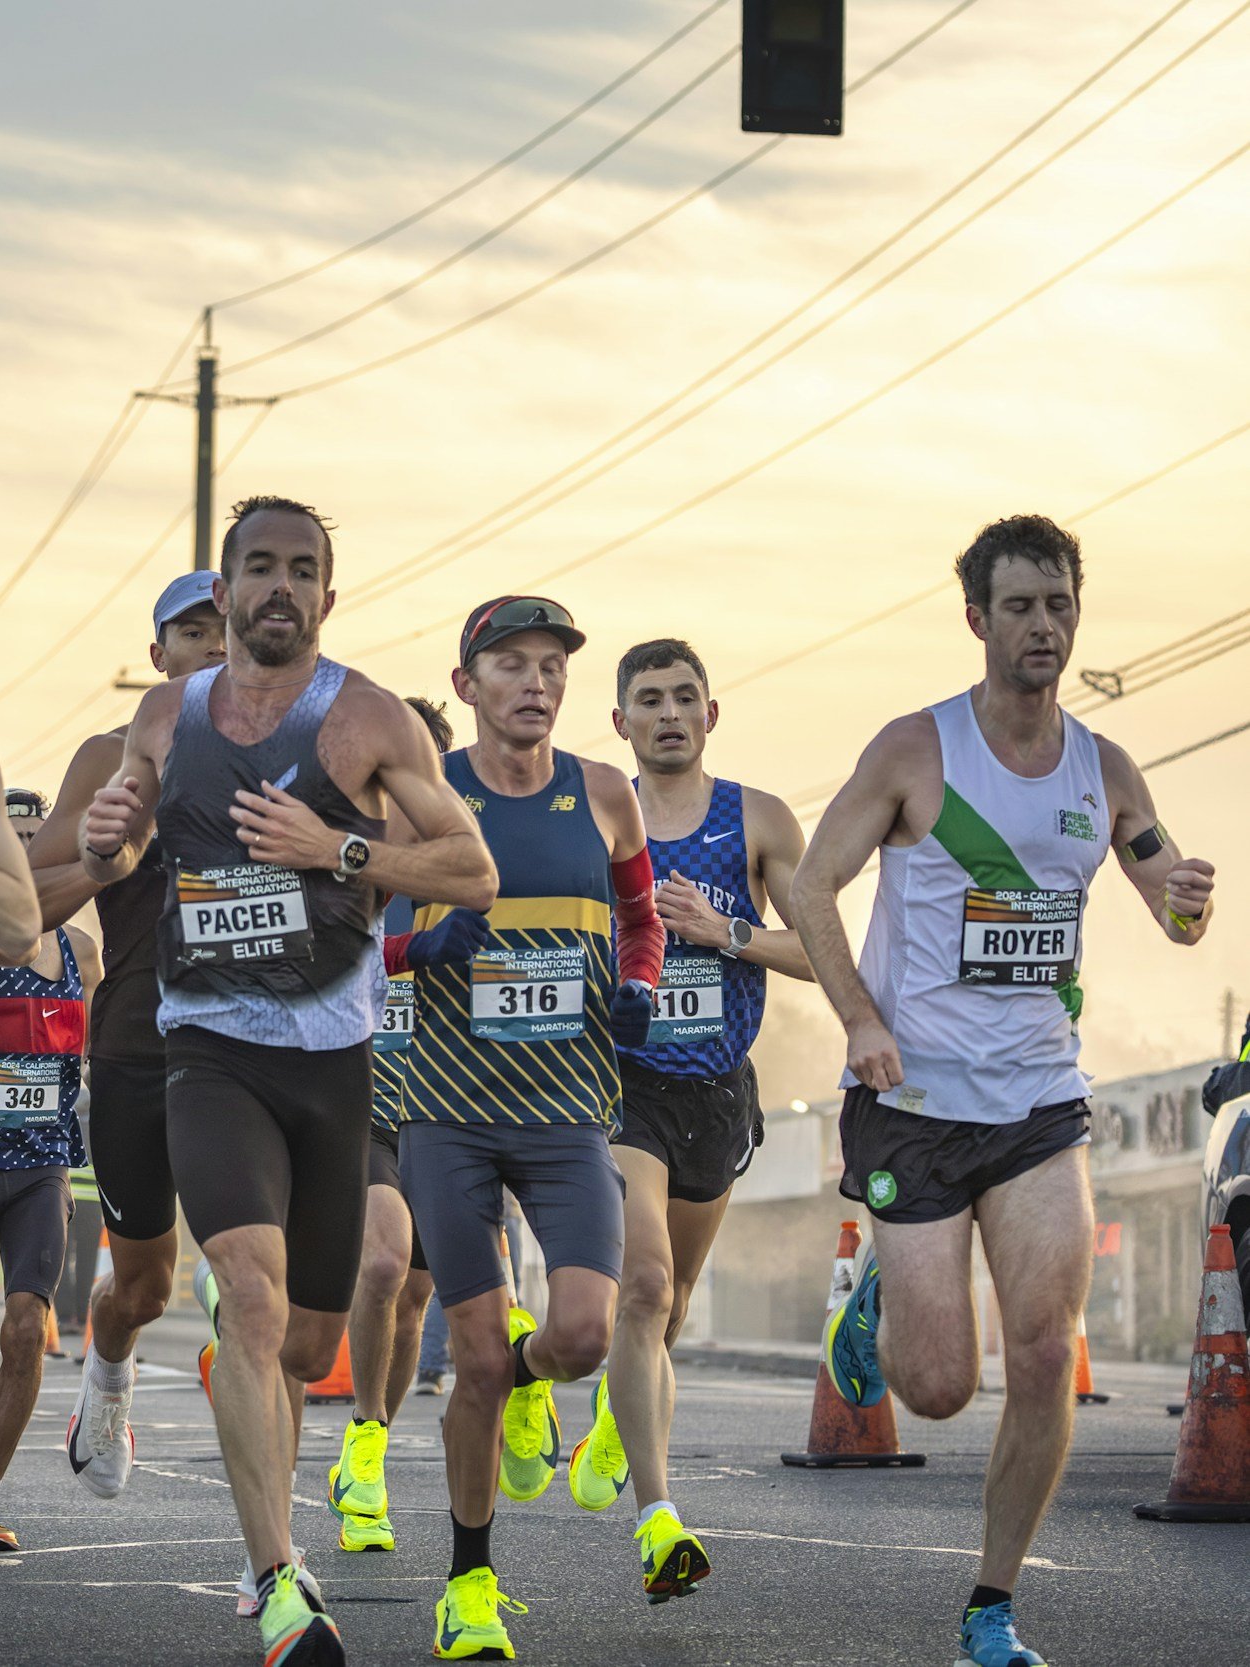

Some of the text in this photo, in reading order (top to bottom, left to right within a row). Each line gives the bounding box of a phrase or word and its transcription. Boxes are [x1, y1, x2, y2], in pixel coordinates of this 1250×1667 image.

[1059, 809, 1090, 822] GREEN
[1060, 818, 1094, 832] RACING
[1061, 827, 1098, 842] PROJECT
[202, 869, 226, 880] 2024
[216, 871, 299, 889] INTERNATIONAL
[239, 880, 301, 896] MARATHON
[995, 891, 1022, 901] 2024
[1011, 900, 1078, 911] INTERNATIONAL
[196, 901, 288, 935] PACER
[1032, 910, 1078, 921] MARATHON
[983, 929, 1065, 955] ROYER
[232, 938, 284, 959] ELITE
[490, 952, 516, 961] 2024
[524, 949, 583, 960] CALIFORNIA
[505, 959, 583, 970] INTERNATIONAL
[665, 958, 721, 968] CALIFORNIA
[527, 968, 583, 979] MARATHON
[1012, 966, 1058, 982] ELITE
[669, 975, 721, 985] MARATHON
[499, 984, 558, 1015] 316
[382, 1008, 409, 1031] 31
[531, 1022, 583, 1033] MARATHON
[673, 1025, 723, 1035] MARATHON
[25, 1061, 61, 1069] CALIFORNIA
[5, 1087, 45, 1109] 349
